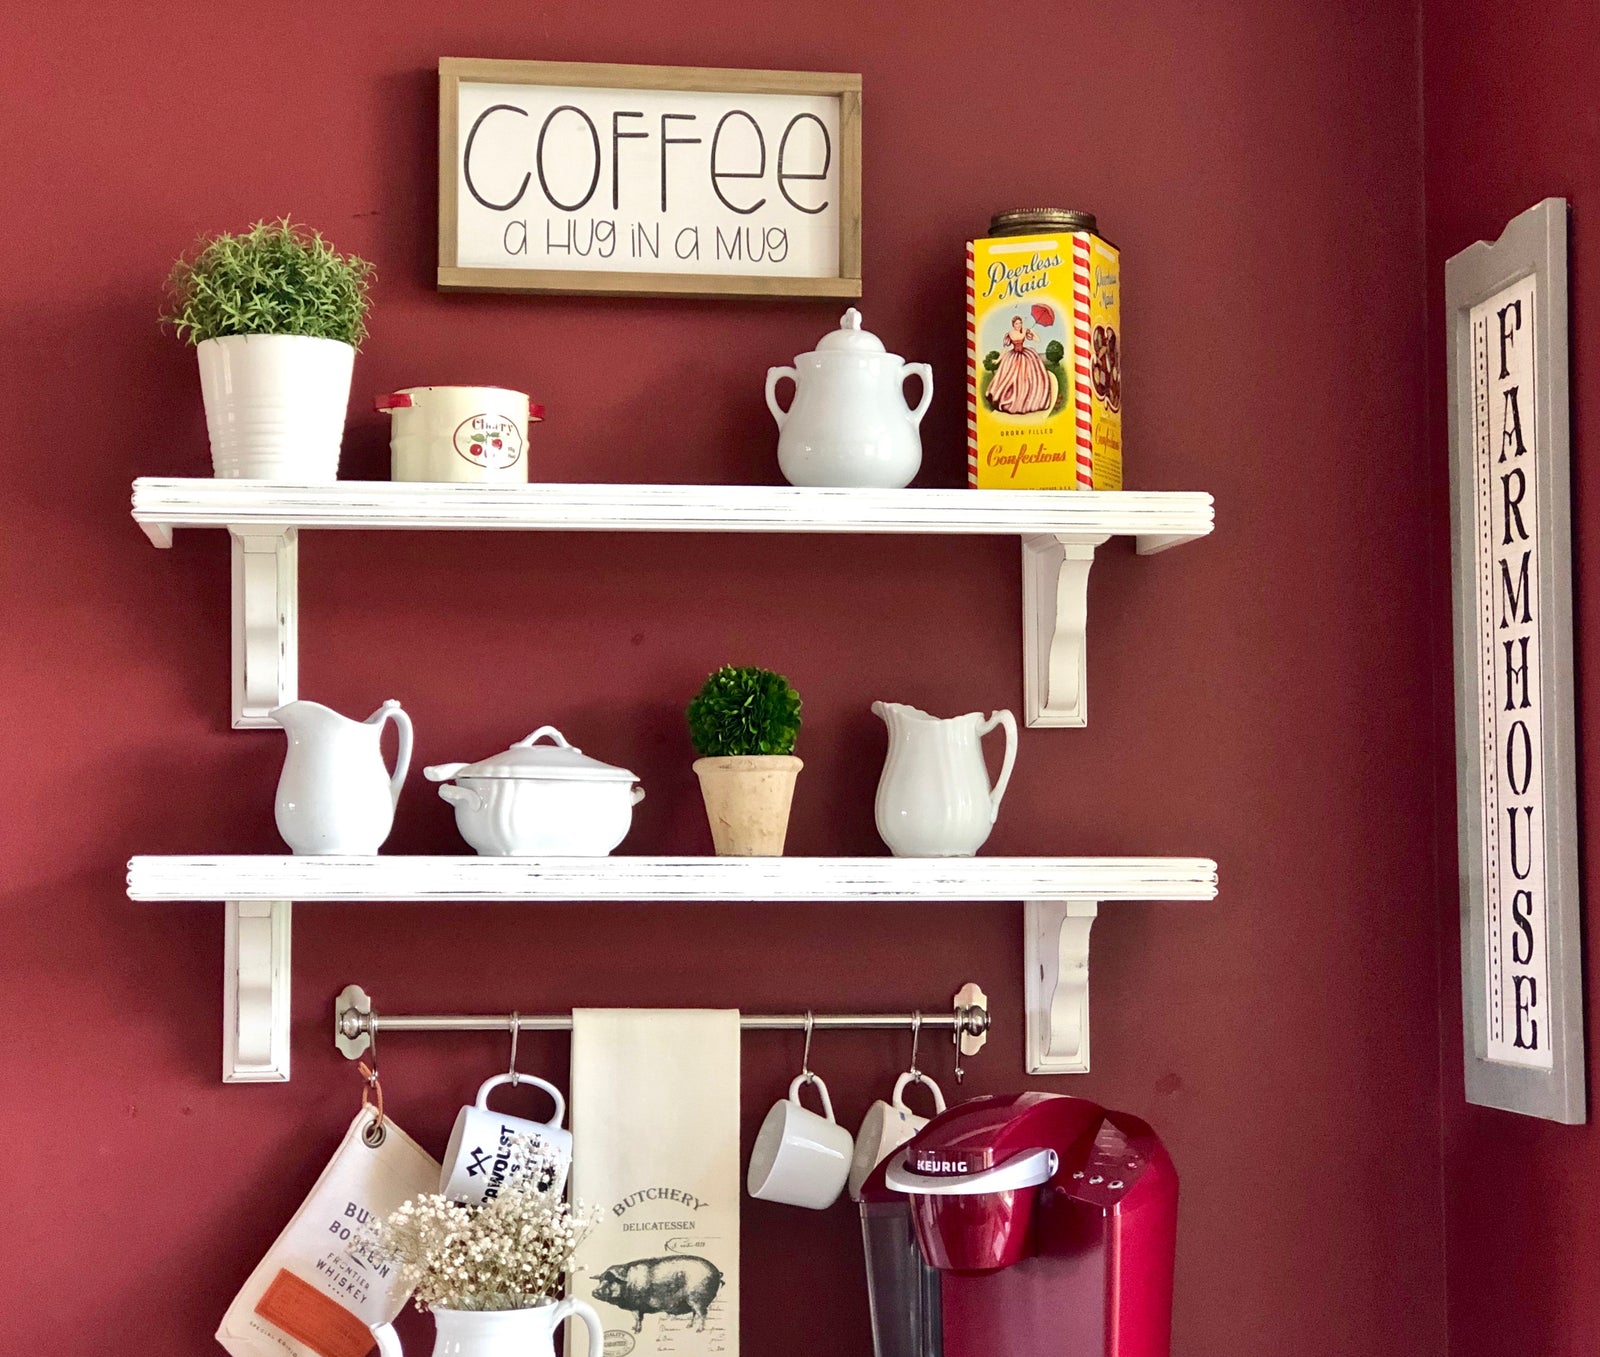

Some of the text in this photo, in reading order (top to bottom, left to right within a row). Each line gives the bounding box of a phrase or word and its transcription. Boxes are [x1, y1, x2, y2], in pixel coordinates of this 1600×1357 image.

[503, 219, 528, 256] a
[674, 225, 699, 261] a
[982, 251, 1063, 298] Peerless
[998, 271, 1049, 300] Maid
[986, 442, 1067, 479] Confections
[1496, 299, 1539, 1051] FARMHOUSE
[916, 1159, 968, 1173] KEURIG
[611, 1187, 710, 1218] BUTCHERY
[622, 1221, 696, 1232] DELICATESSEN
[315, 1258, 368, 1304] WHISKEY
